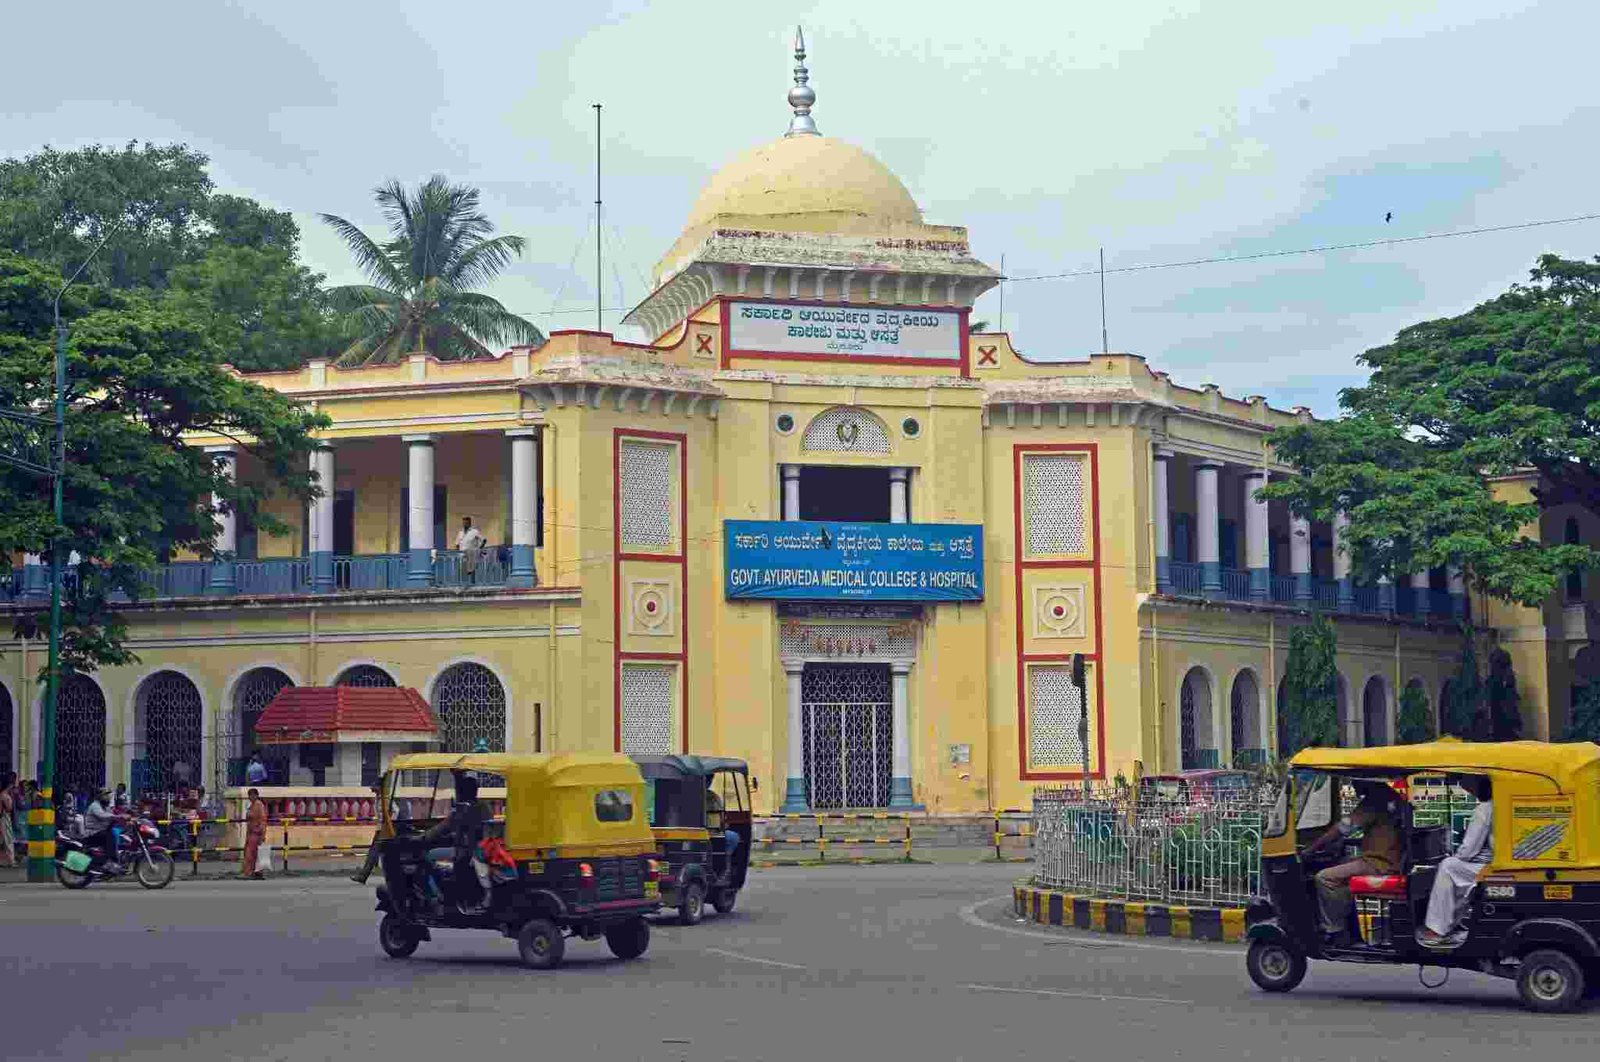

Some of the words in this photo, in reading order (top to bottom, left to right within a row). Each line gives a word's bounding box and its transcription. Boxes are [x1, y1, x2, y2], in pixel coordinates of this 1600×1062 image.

[731, 568, 761, 585] GOVT.
[763, 569, 820, 586] AYURVEDA
[821, 570, 867, 587] MEDICAL
[870, 570, 917, 587] COLLEGE
[920, 571, 927, 587] &
[930, 571, 978, 588] HOSPITAL
